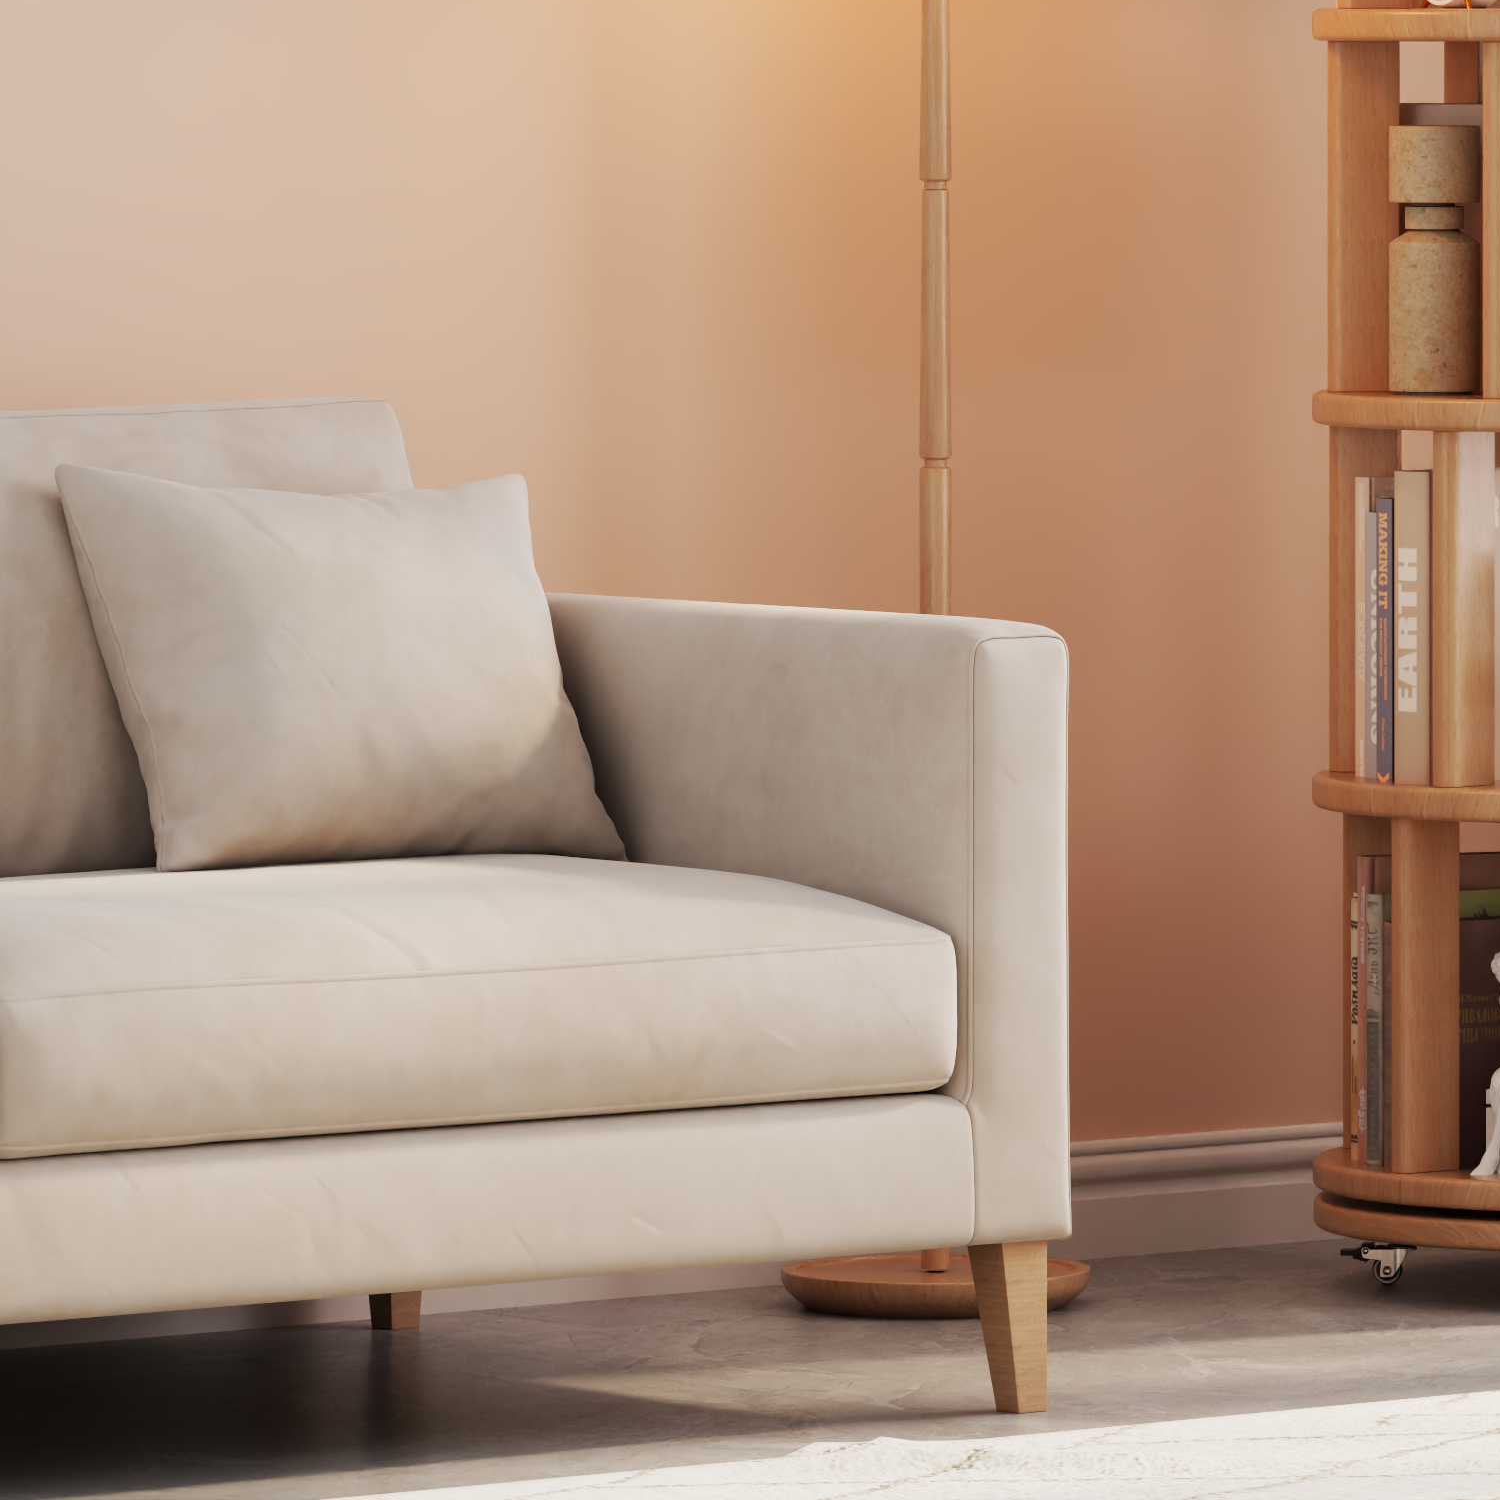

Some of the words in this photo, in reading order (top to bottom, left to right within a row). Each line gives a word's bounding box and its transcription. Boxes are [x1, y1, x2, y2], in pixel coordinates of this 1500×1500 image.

[1378, 512, 1388, 586] MAKING
[1378, 590, 1388, 610] IT
[1398, 548, 1418, 712] EARTH
